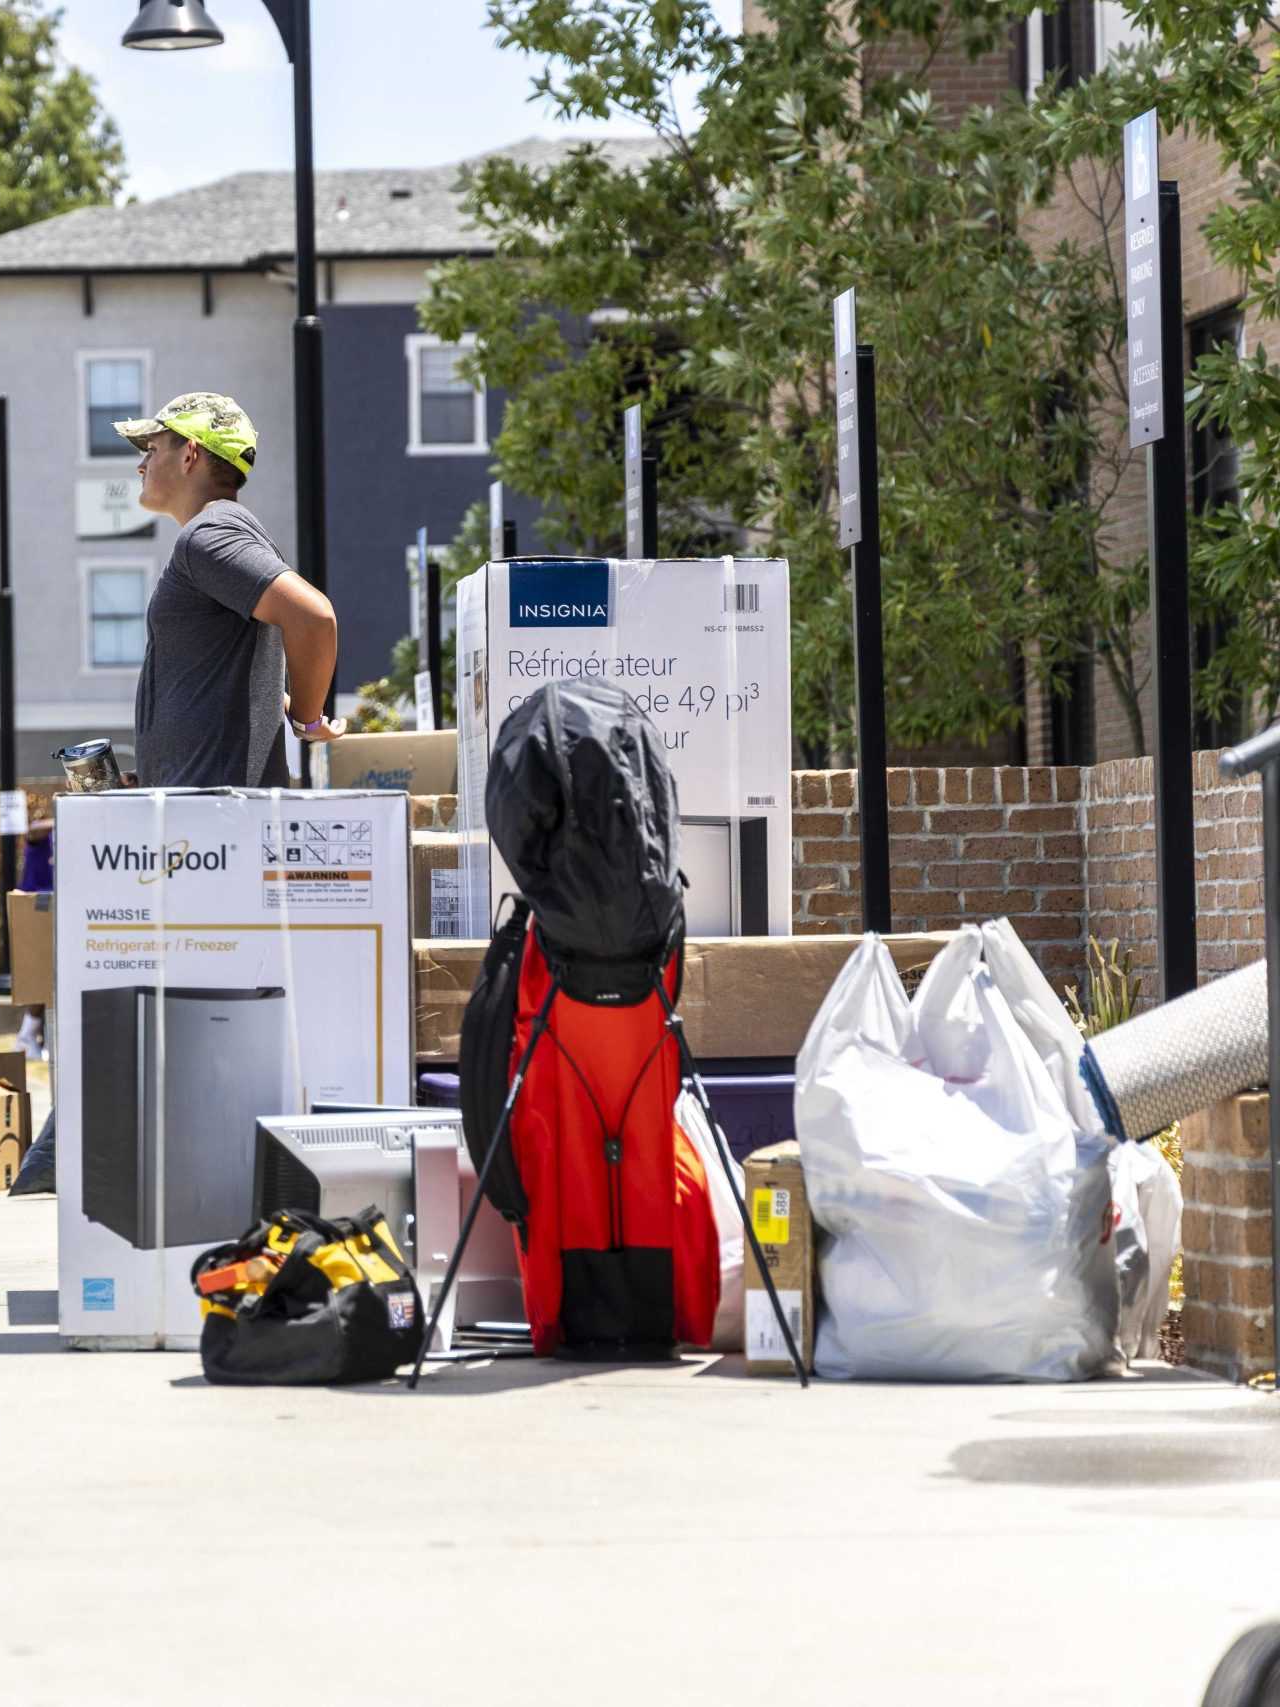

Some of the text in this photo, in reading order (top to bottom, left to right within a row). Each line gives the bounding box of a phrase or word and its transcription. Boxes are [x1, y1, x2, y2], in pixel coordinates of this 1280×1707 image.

[520, 604, 606, 617] INSIGNIA
[634, 685, 669, 713] de
[678, 685, 716, 717] 4,9
[91, 843, 227, 879] Whirlpool
[295, 871, 349, 880] WARNING
[86, 909, 151, 921] WH43S1E
[185, 938, 239, 951] Freezer
[85, 960, 162, 970] 4.3 CUBIC FEE
